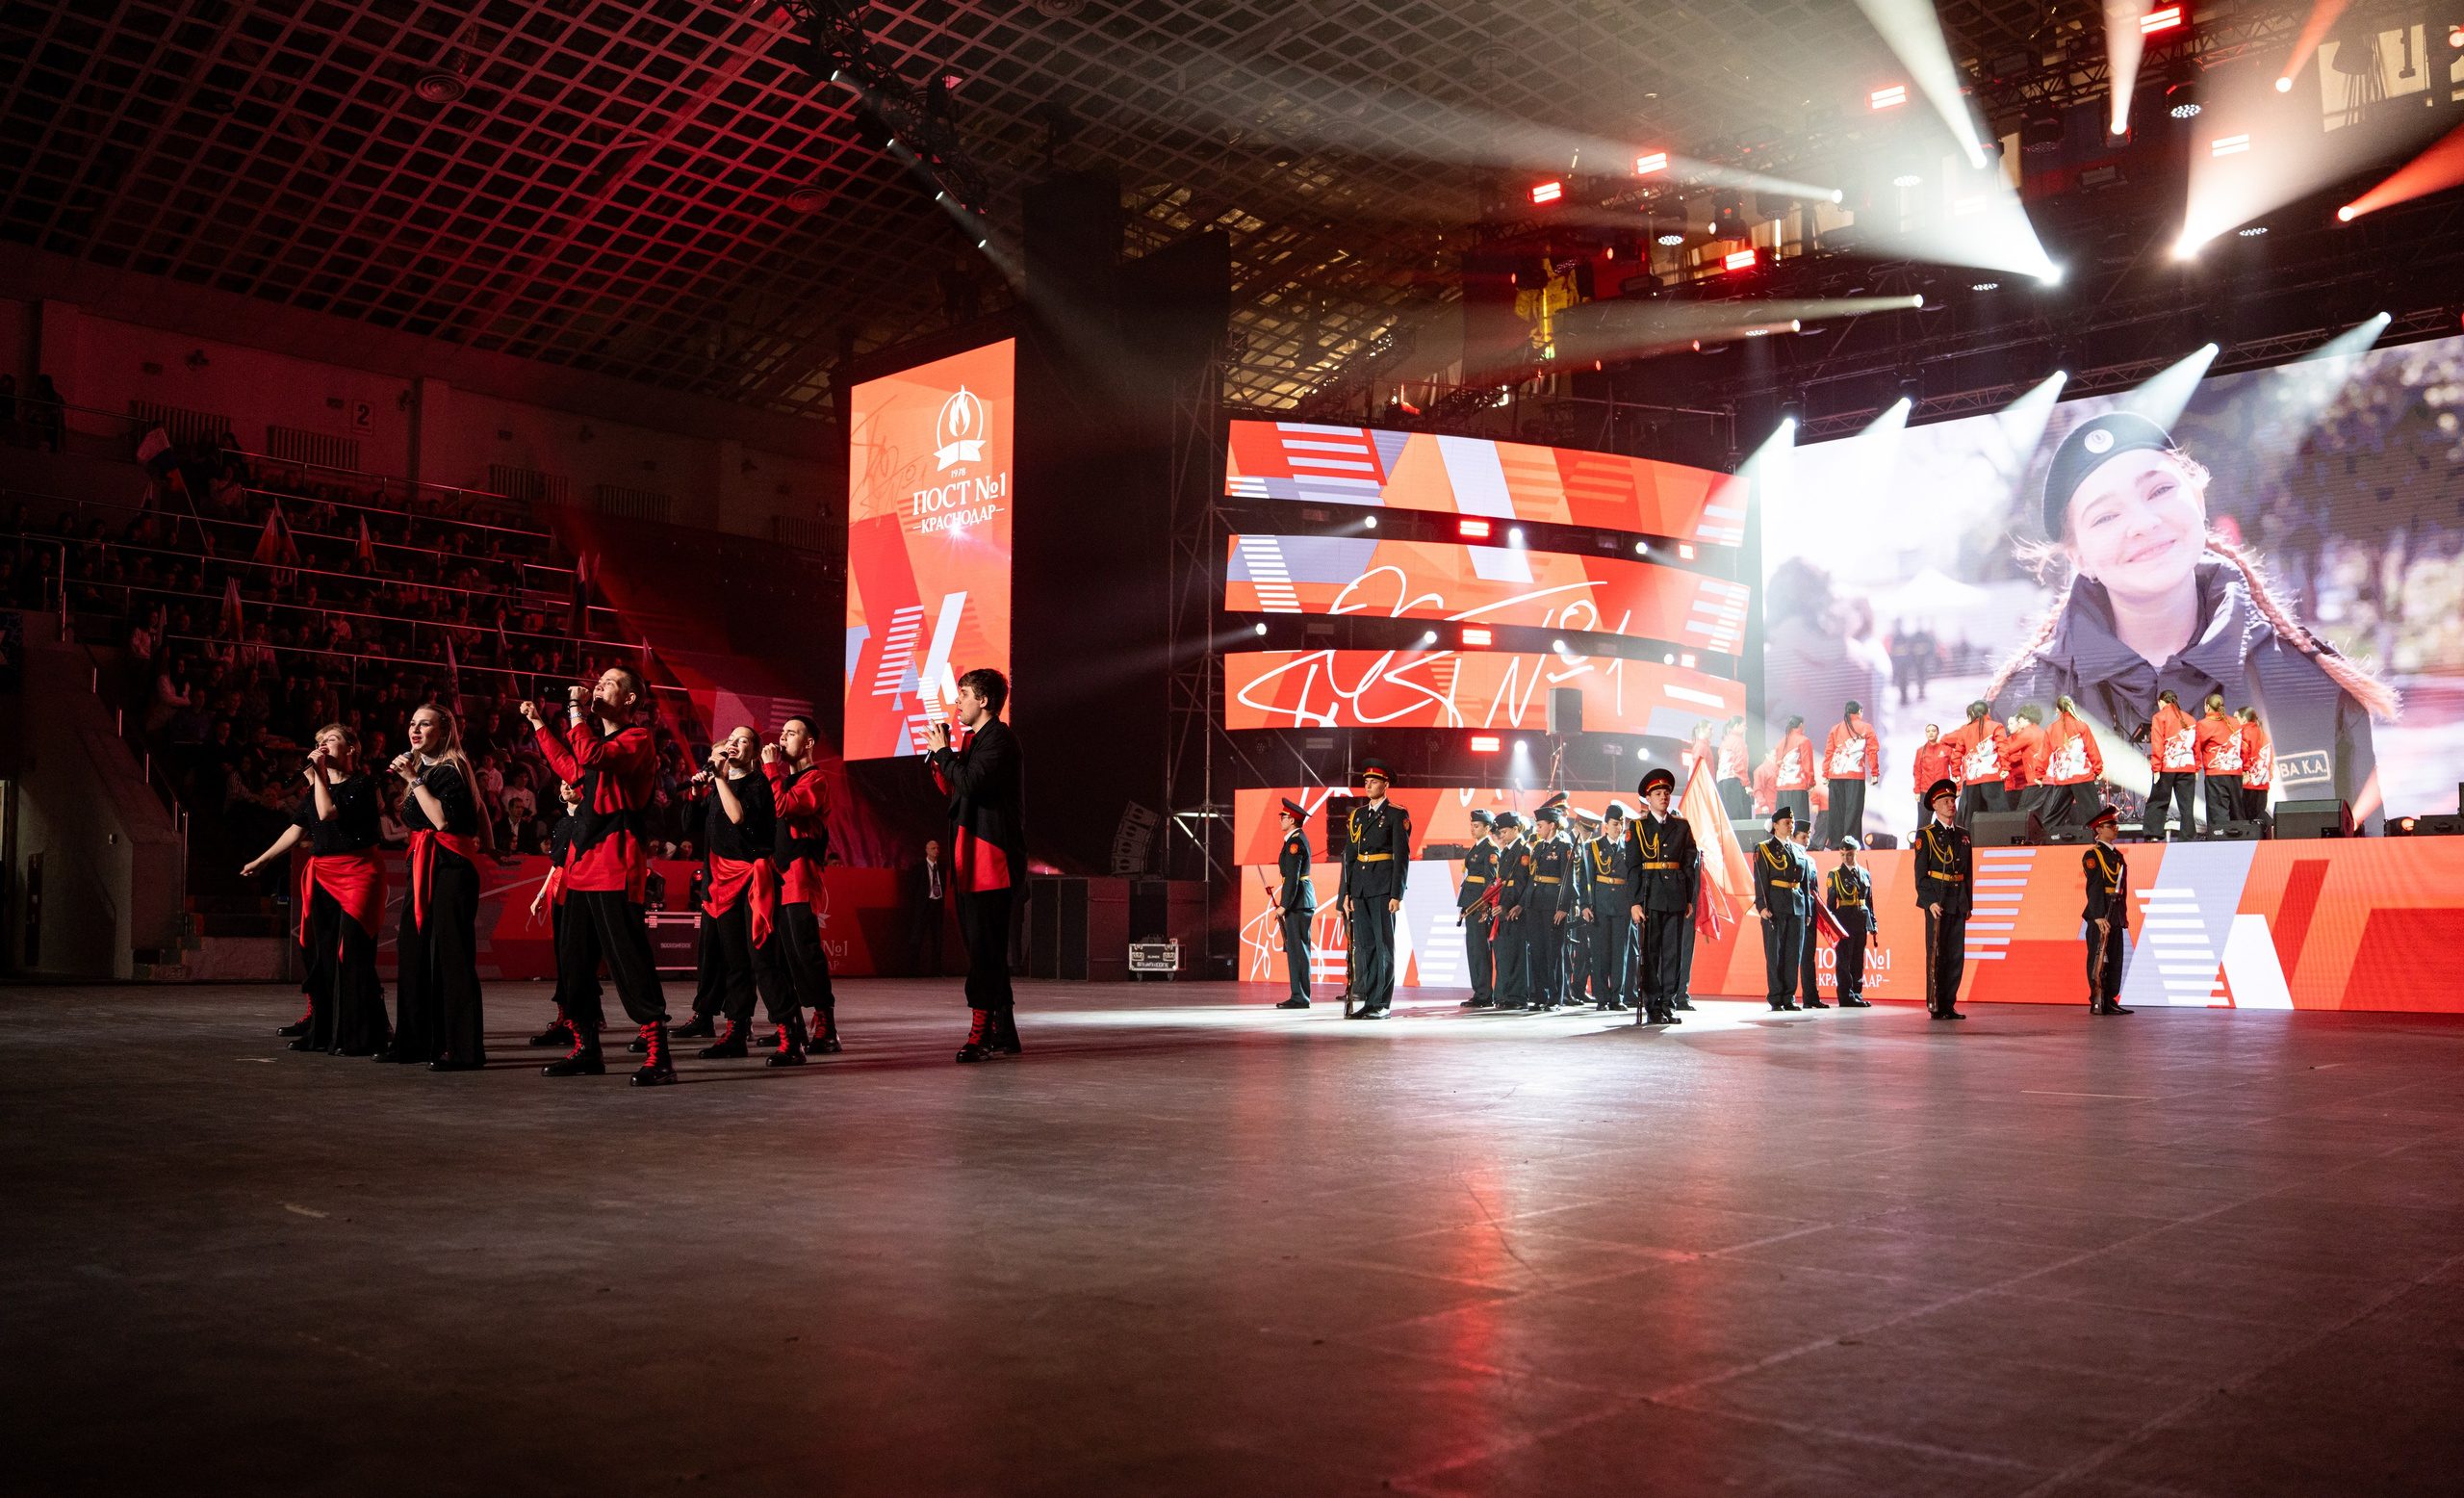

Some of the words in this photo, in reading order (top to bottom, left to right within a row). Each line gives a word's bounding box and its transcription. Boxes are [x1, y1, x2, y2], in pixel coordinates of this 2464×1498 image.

[357, 404, 370, 426] 2
[951, 467, 966, 478] 1978
[912, 480, 970, 516] ПОСТ
[975, 472, 1006, 502] №1
[1863, 947, 1890, 970] №1
